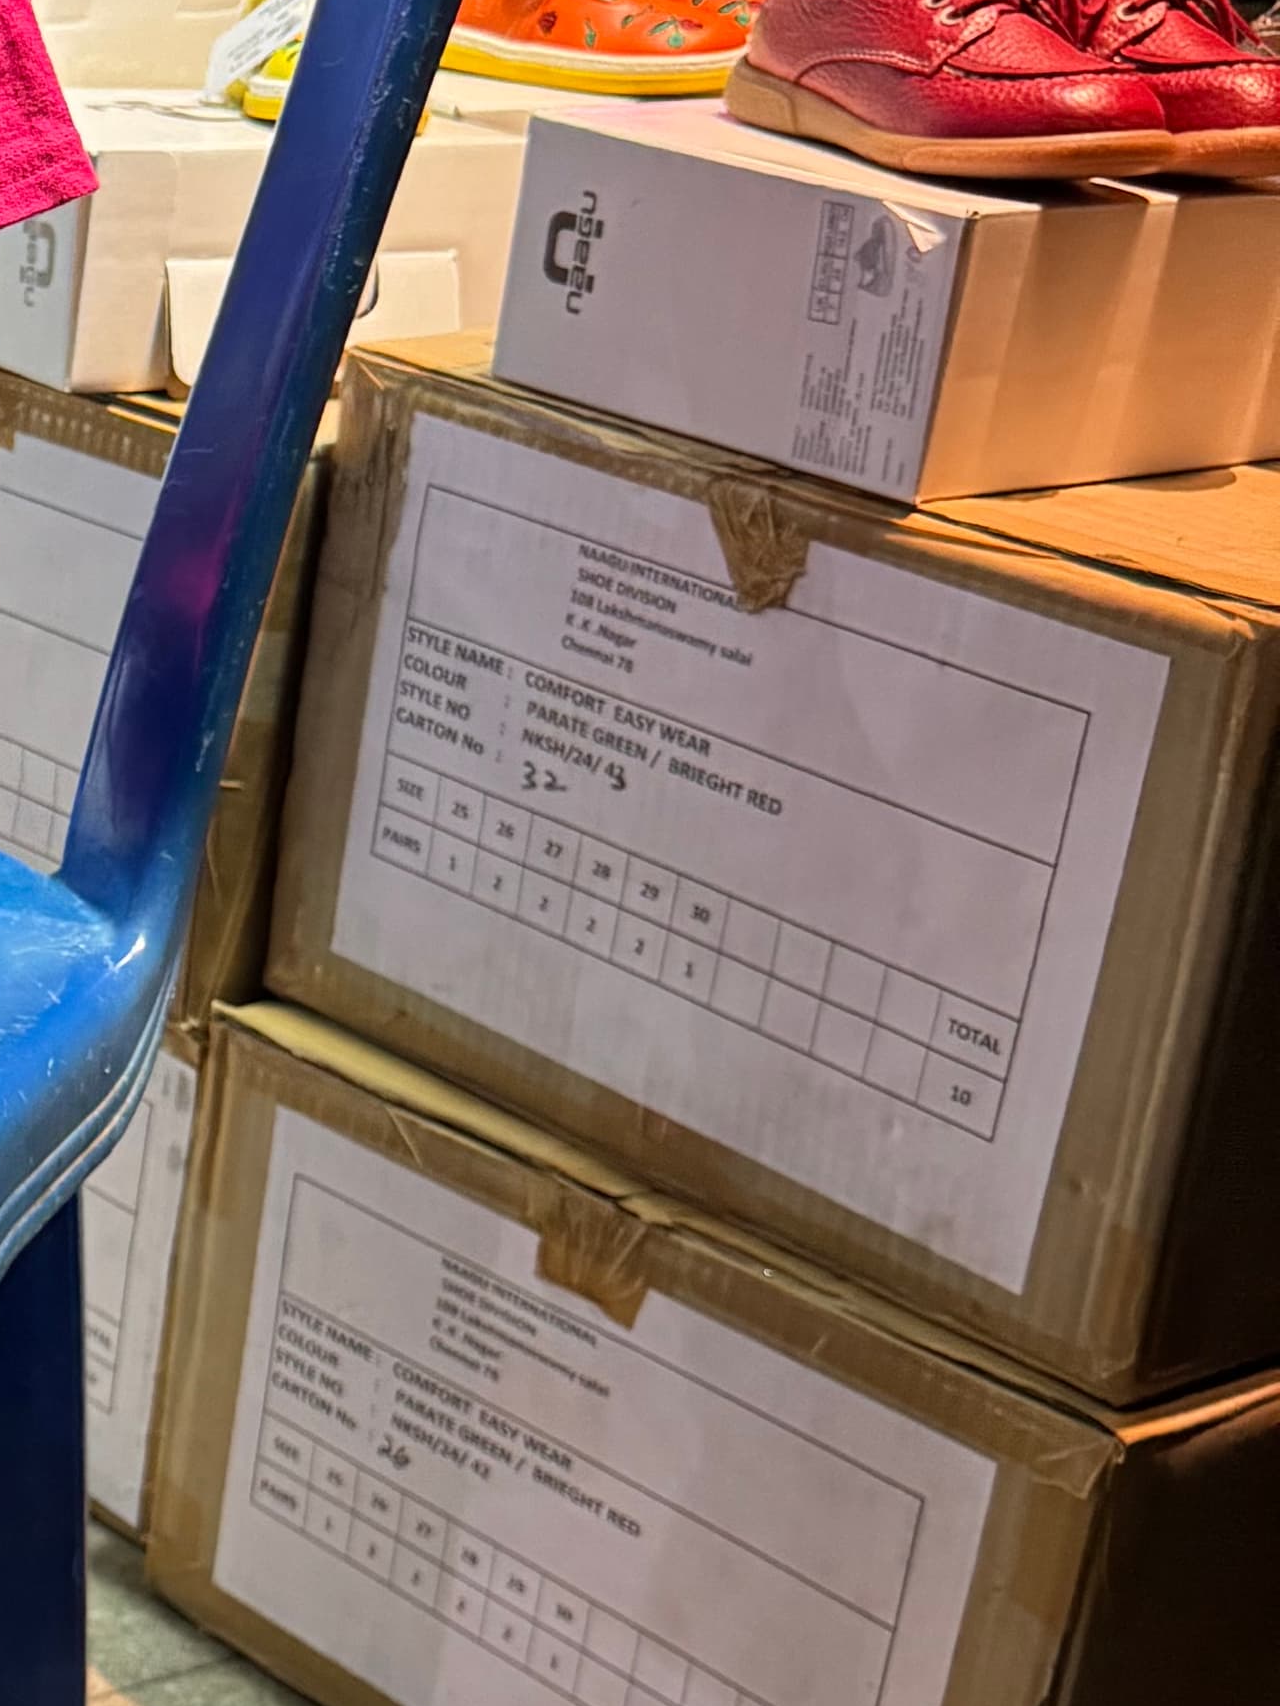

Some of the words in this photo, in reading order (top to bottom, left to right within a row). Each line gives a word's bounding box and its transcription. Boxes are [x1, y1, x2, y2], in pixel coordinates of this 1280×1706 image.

[578, 567, 613, 594] SHOE
[615, 578, 677, 615] DIVISION
[629, 560, 744, 613] INTERNATIONA
[398, 679, 445, 709] STYLE
[445, 697, 472, 721] NO
[406, 625, 453, 657] STYLE
[454, 641, 506, 676] NAME
[524, 670, 607, 715] COMFORT
[613, 705, 656, 740] EASY
[658, 723, 712, 758] WEAR
[395, 706, 459, 747] CARTON
[461, 732, 486, 756] No
[402, 652, 469, 691] COLOUR
[526, 701, 590, 742] PARATE
[592, 724, 649, 764] GREEN
[668, 755, 745, 801] BRIEGHT
[746, 787, 783, 818] RED
[520, 759, 569, 793] 32
[396, 777, 425, 802] SIZE
[451, 801, 470, 820] 25
[543, 840, 564, 860] 27
[591, 860, 612, 880] 28
[640, 882, 661, 902] 29
[689, 905, 711, 925] 30
[948, 1017, 1002, 1056] TOTAL
[950, 1084, 973, 1107] 10
[273, 1346, 318, 1382] STYLE
[280, 1299, 325, 1332] STYLE
[325, 1322, 375, 1362] NAME
[392, 1361, 473, 1415] COMFORT
[478, 1408, 520, 1445] EASY
[521, 1431, 574, 1472] WEAR
[271, 1370, 333, 1418] CARTON
[277, 1324, 340, 1368] COLOUR
[457, 1424, 513, 1467] GREEN
[605, 1506, 642, 1538] RED
